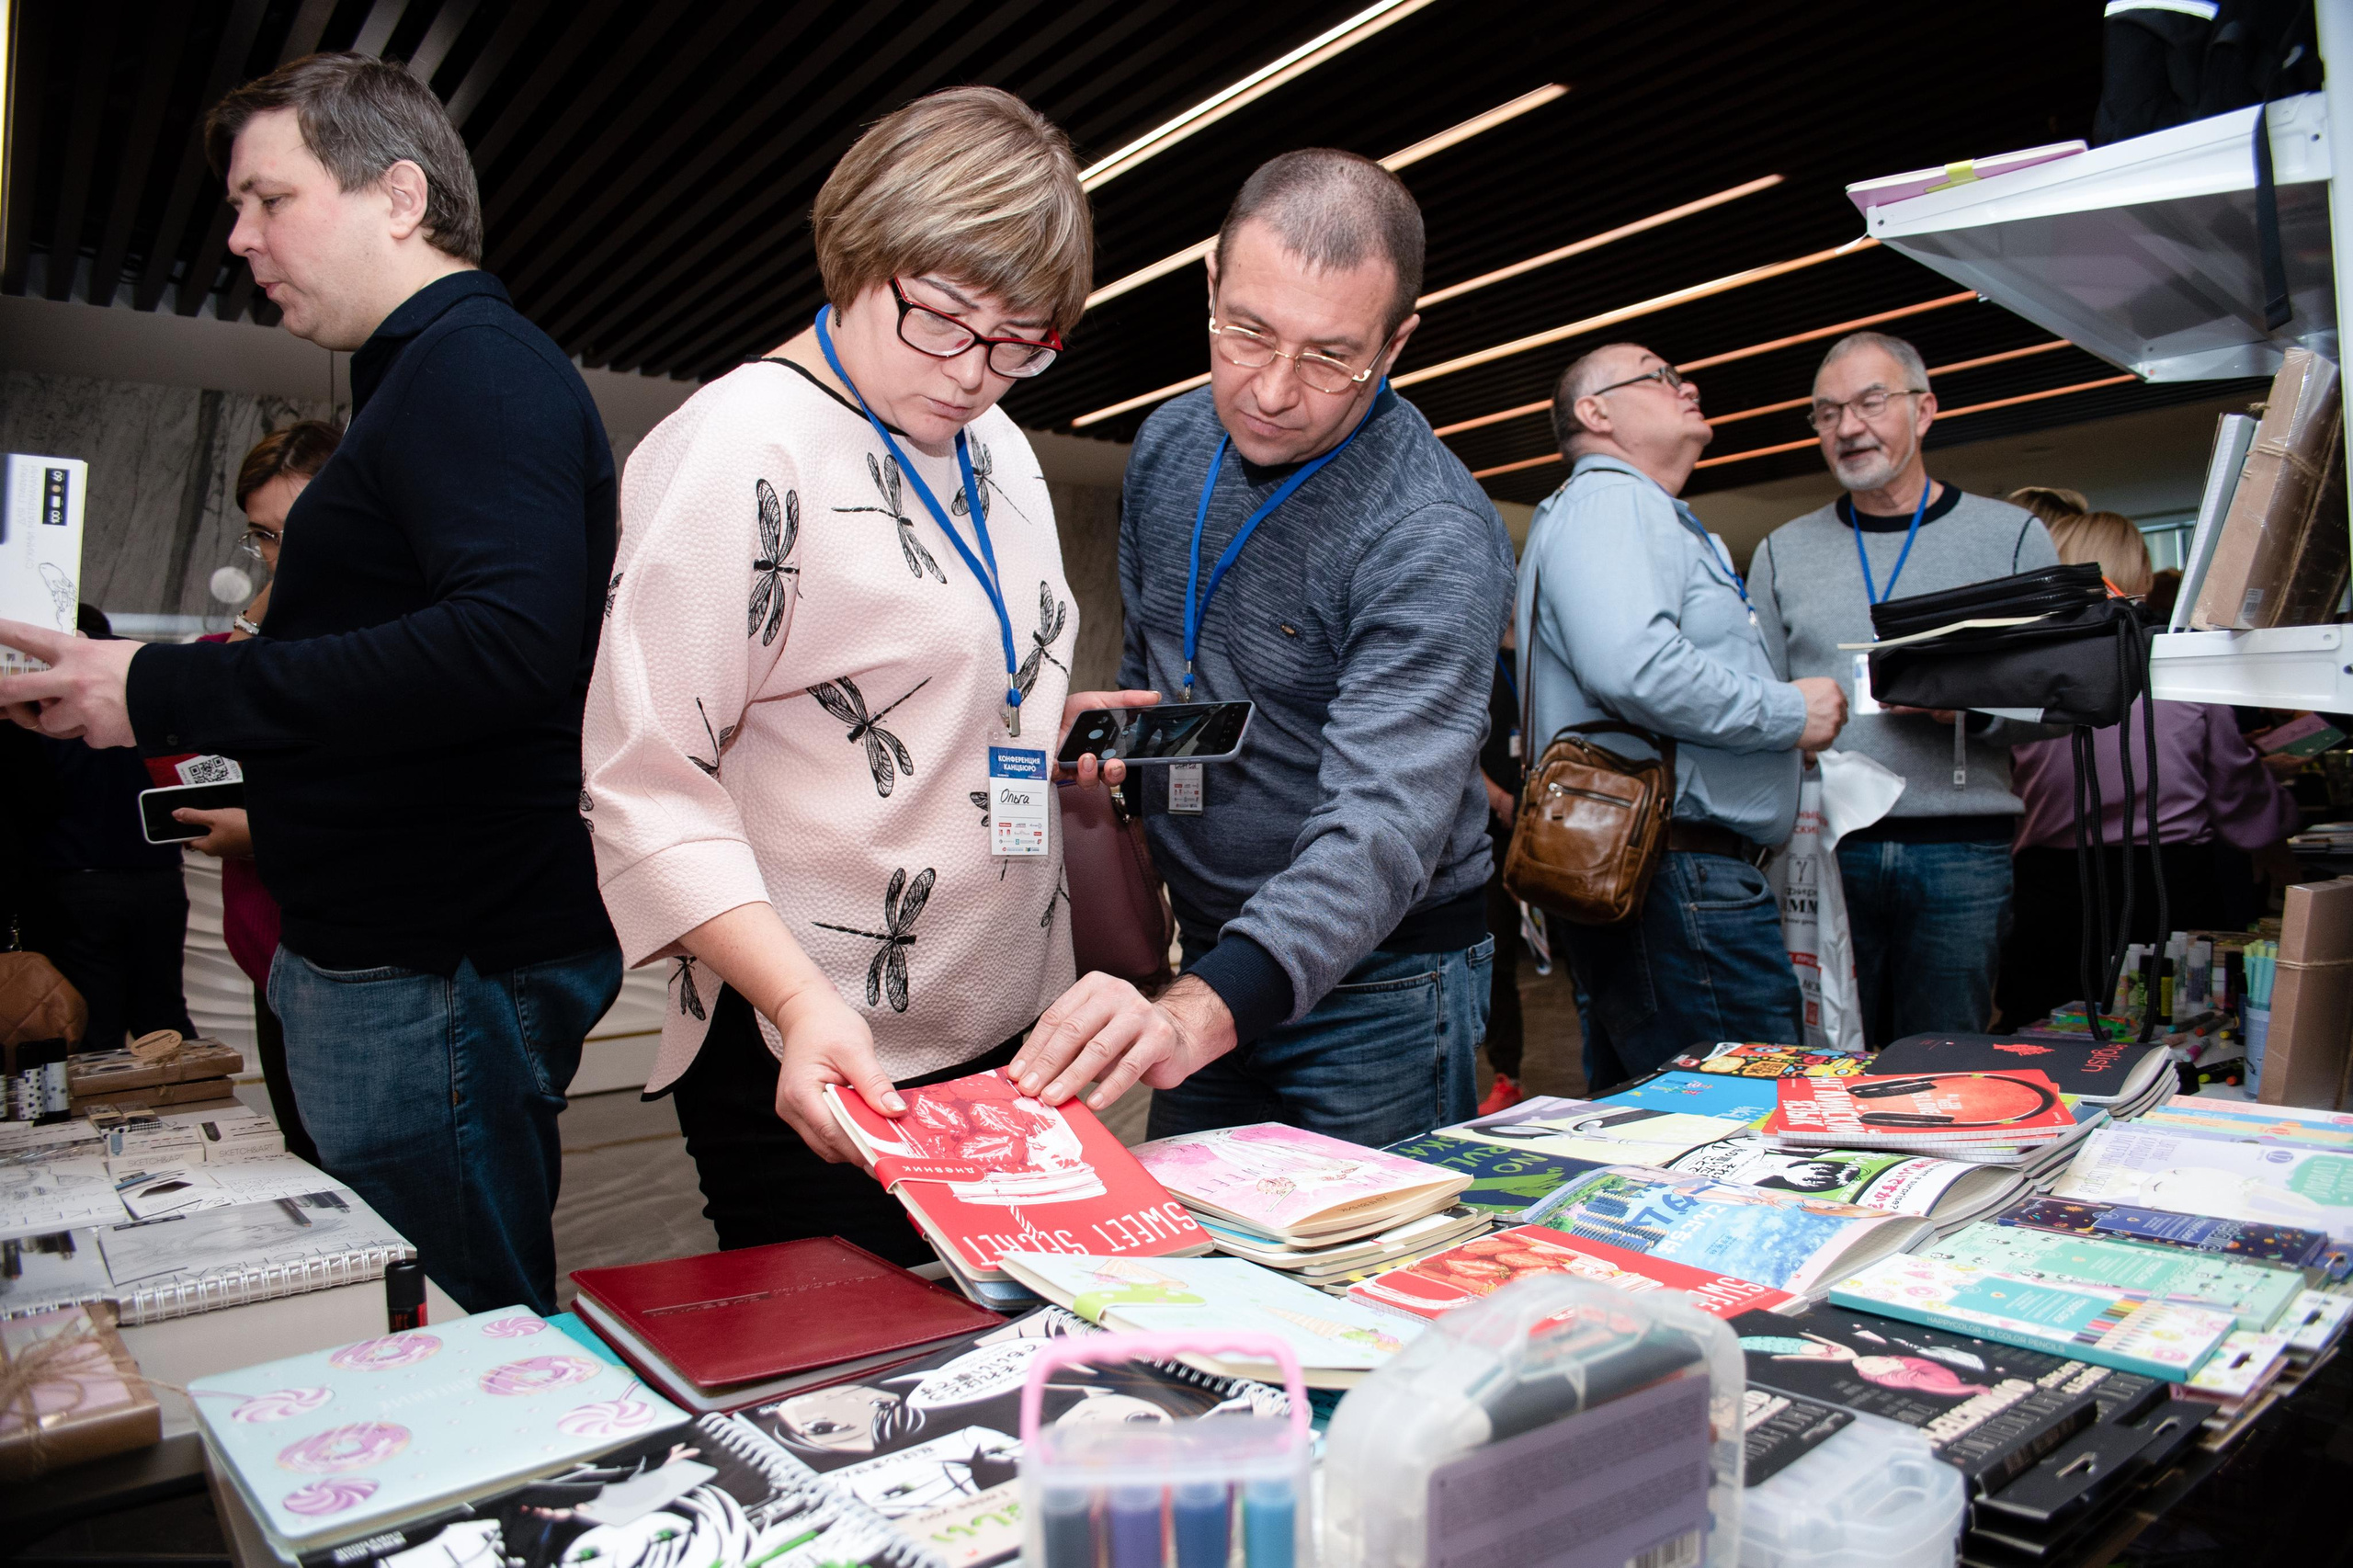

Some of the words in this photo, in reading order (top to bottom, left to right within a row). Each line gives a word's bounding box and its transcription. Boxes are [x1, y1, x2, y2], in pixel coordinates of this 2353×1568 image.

[997, 754, 1040, 766] КОНФЕРЕНЦИЯ
[1003, 763, 1037, 773] КАНЦБЮРО
[1000, 788, 1030, 805] Ольга
[1782, 1099, 1824, 1127] ЯЗЫК
[128, 1154, 185, 1168] SKETCH&ART
[219, 1144, 274, 1158] SKETCH&ART
[1490, 1148, 1548, 1174] NO
[902, 1163, 975, 1176] ДНЕВНИК
[1889, 1181, 1917, 1210] surprise?
[1088, 1201, 1199, 1253] SWEET
[1656, 1204, 1727, 1256] こんにちは
[1927, 1315, 1982, 1335] HAPPYCOLOR
[1987, 1329, 1995, 1337] 12
[1996, 1331, 2027, 1345] COLOR
[2028, 1337, 2066, 1354] PENCILS
[926, 1364, 1017, 1403] それはどう
